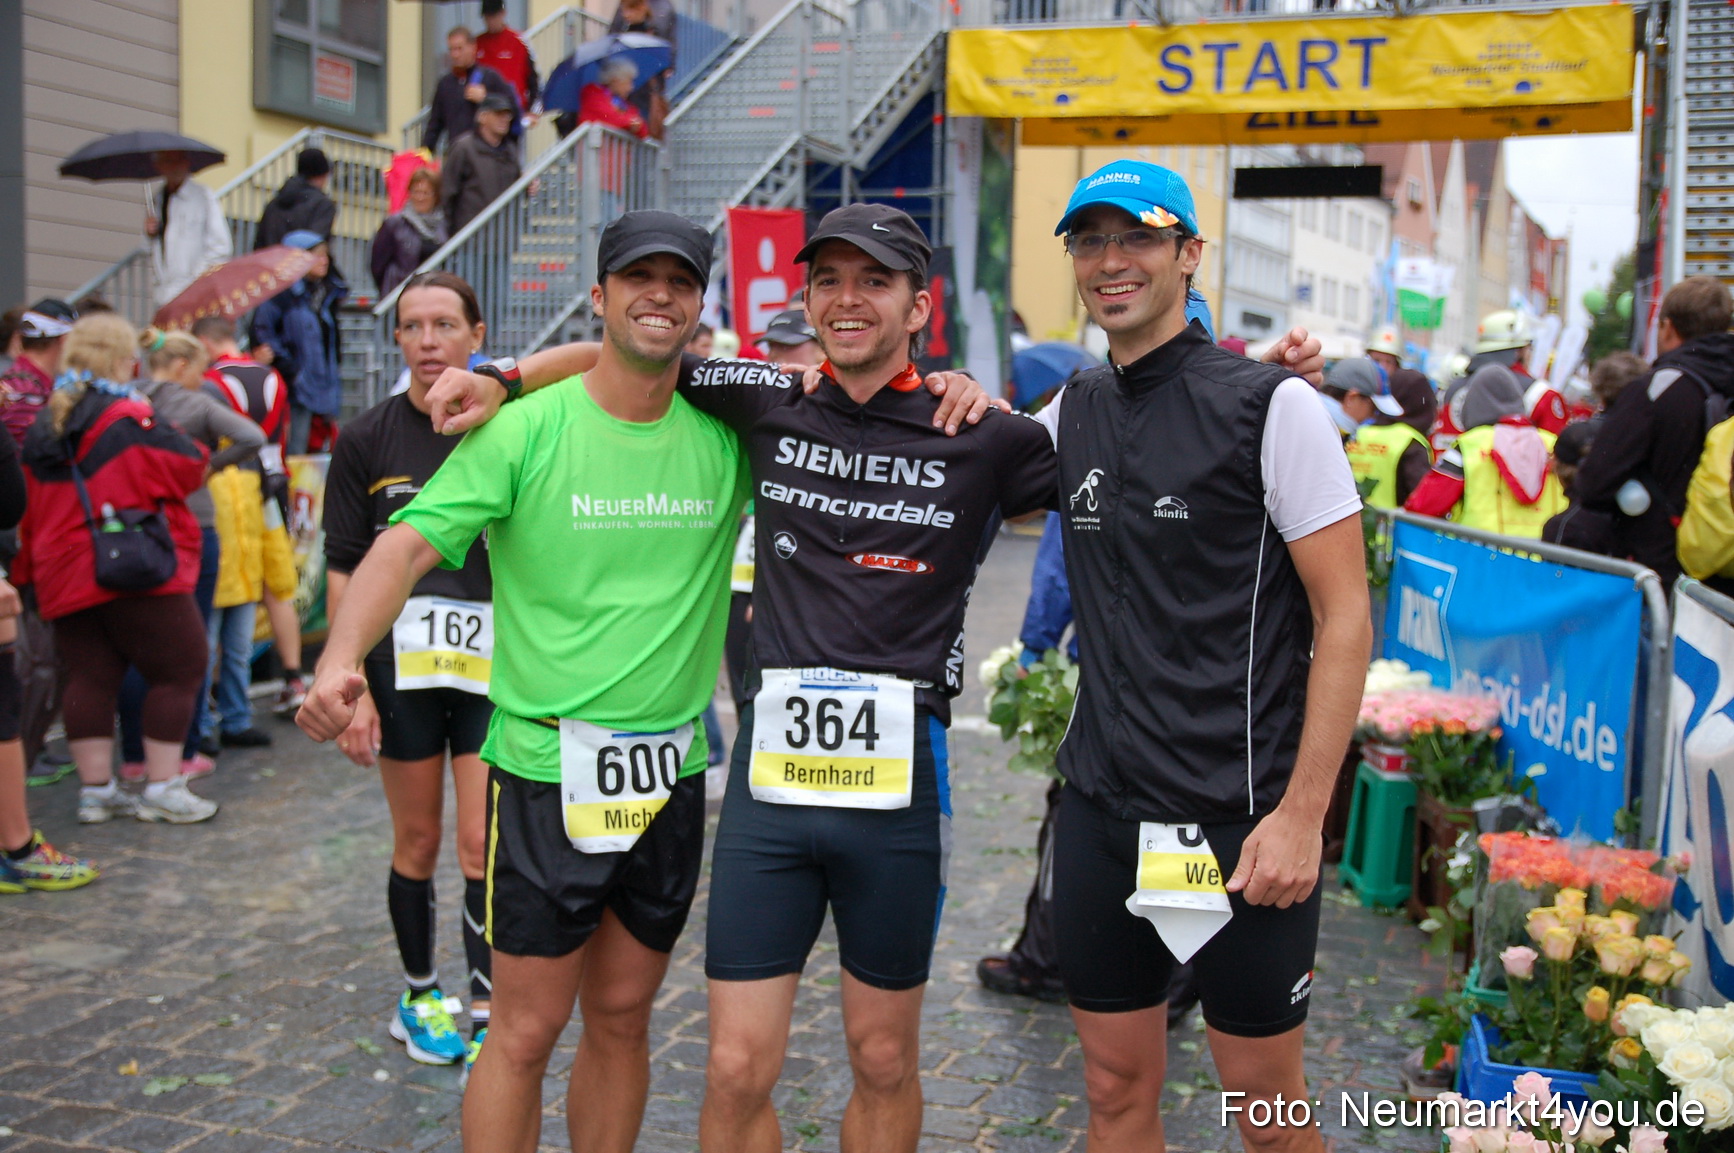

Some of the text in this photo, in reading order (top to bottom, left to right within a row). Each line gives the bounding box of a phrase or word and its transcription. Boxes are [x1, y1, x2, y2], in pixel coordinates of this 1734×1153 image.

[1157, 37, 1388, 95] START
[690, 365, 793, 389] SIEMENS
[774, 436, 947, 489] SIEMENS
[760, 480, 955, 529] cannondale
[1153, 509, 1189, 519] skinfit
[573, 520, 717, 531] EINKAUFEN. WOHNEN. LEBEN.
[860, 553, 919, 573] MAXXIS
[420, 610, 482, 652] 162
[433, 655, 468, 674] Karin
[785, 696, 880, 752] 364
[597, 741, 680, 797] 600
[784, 761, 875, 787] Bernhard
[569, 793, 575, 802] B
[1147, 840, 1153, 850] C
